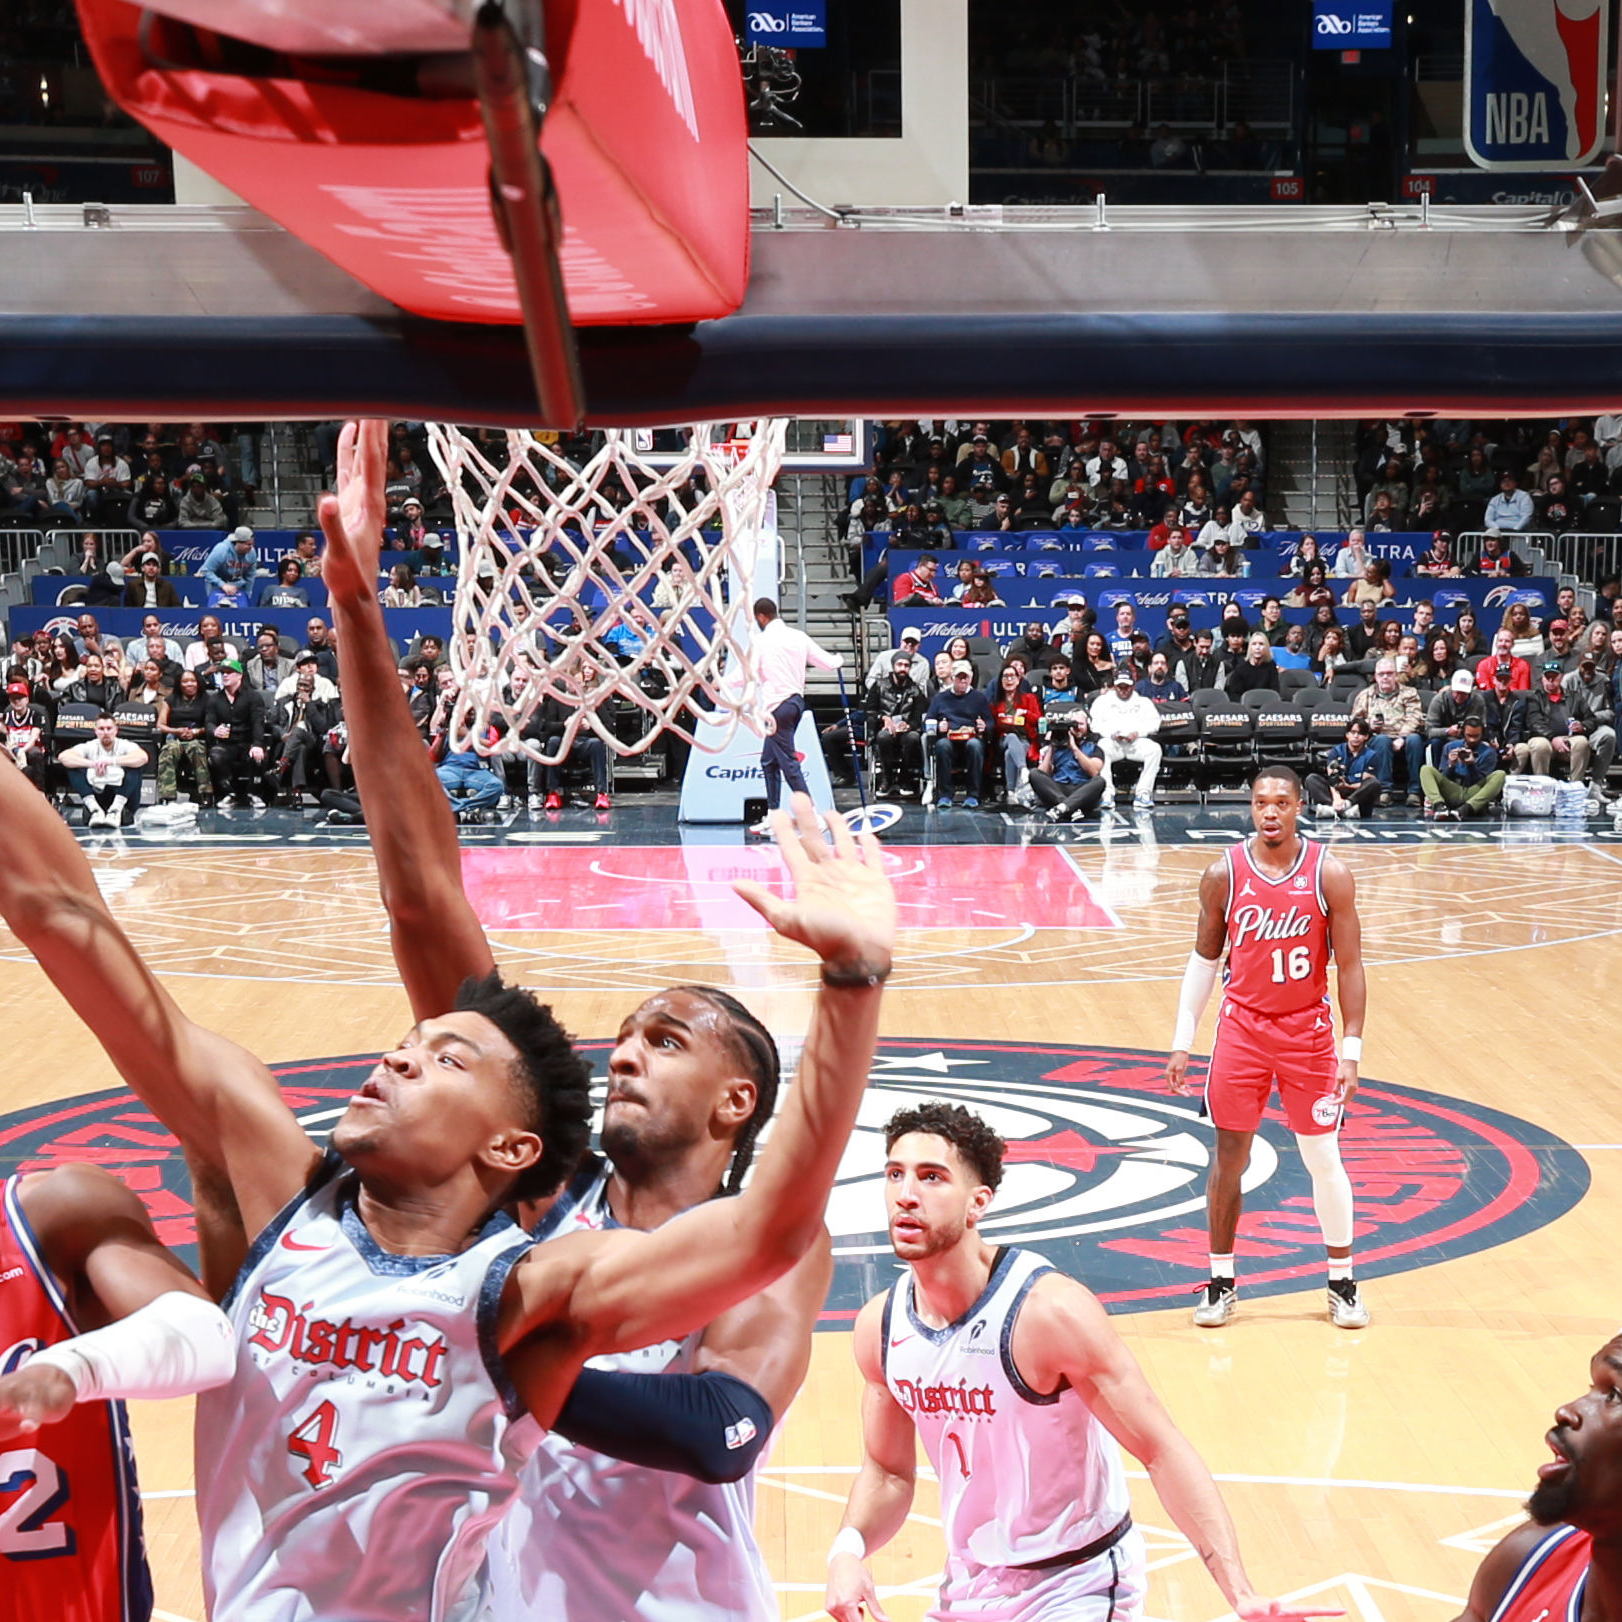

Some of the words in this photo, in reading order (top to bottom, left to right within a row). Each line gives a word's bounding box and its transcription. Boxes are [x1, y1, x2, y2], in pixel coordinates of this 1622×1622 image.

[1485, 92, 1550, 145] NBA
[136, 170, 160, 184] 107
[1275, 180, 1300, 195] 105
[1407, 180, 1431, 193] 104
[920, 621, 977, 638] Michelob
[993, 622, 1053, 638] ULTA
[56, 720, 96, 730] SPORTSBOO
[113, 712, 156, 723] CAESARS
[1160, 711, 1195, 723] AESARS
[1206, 712, 1250, 723] CAESARS
[1258, 712, 1303, 723] CAESARS
[704, 764, 810, 783] Capitae
[1234, 904, 1313, 948] Phila
[1271, 945, 1312, 984] 16
[395, 1284, 466, 1308] Robinhood
[249, 1299, 280, 1334] the
[247, 1286, 449, 1389] District
[290, 1363, 431, 1403] COLUMBIA
[892, 1375, 997, 1417] District
[287, 1398, 345, 1493] 4
[947, 1431, 973, 1482] 1
